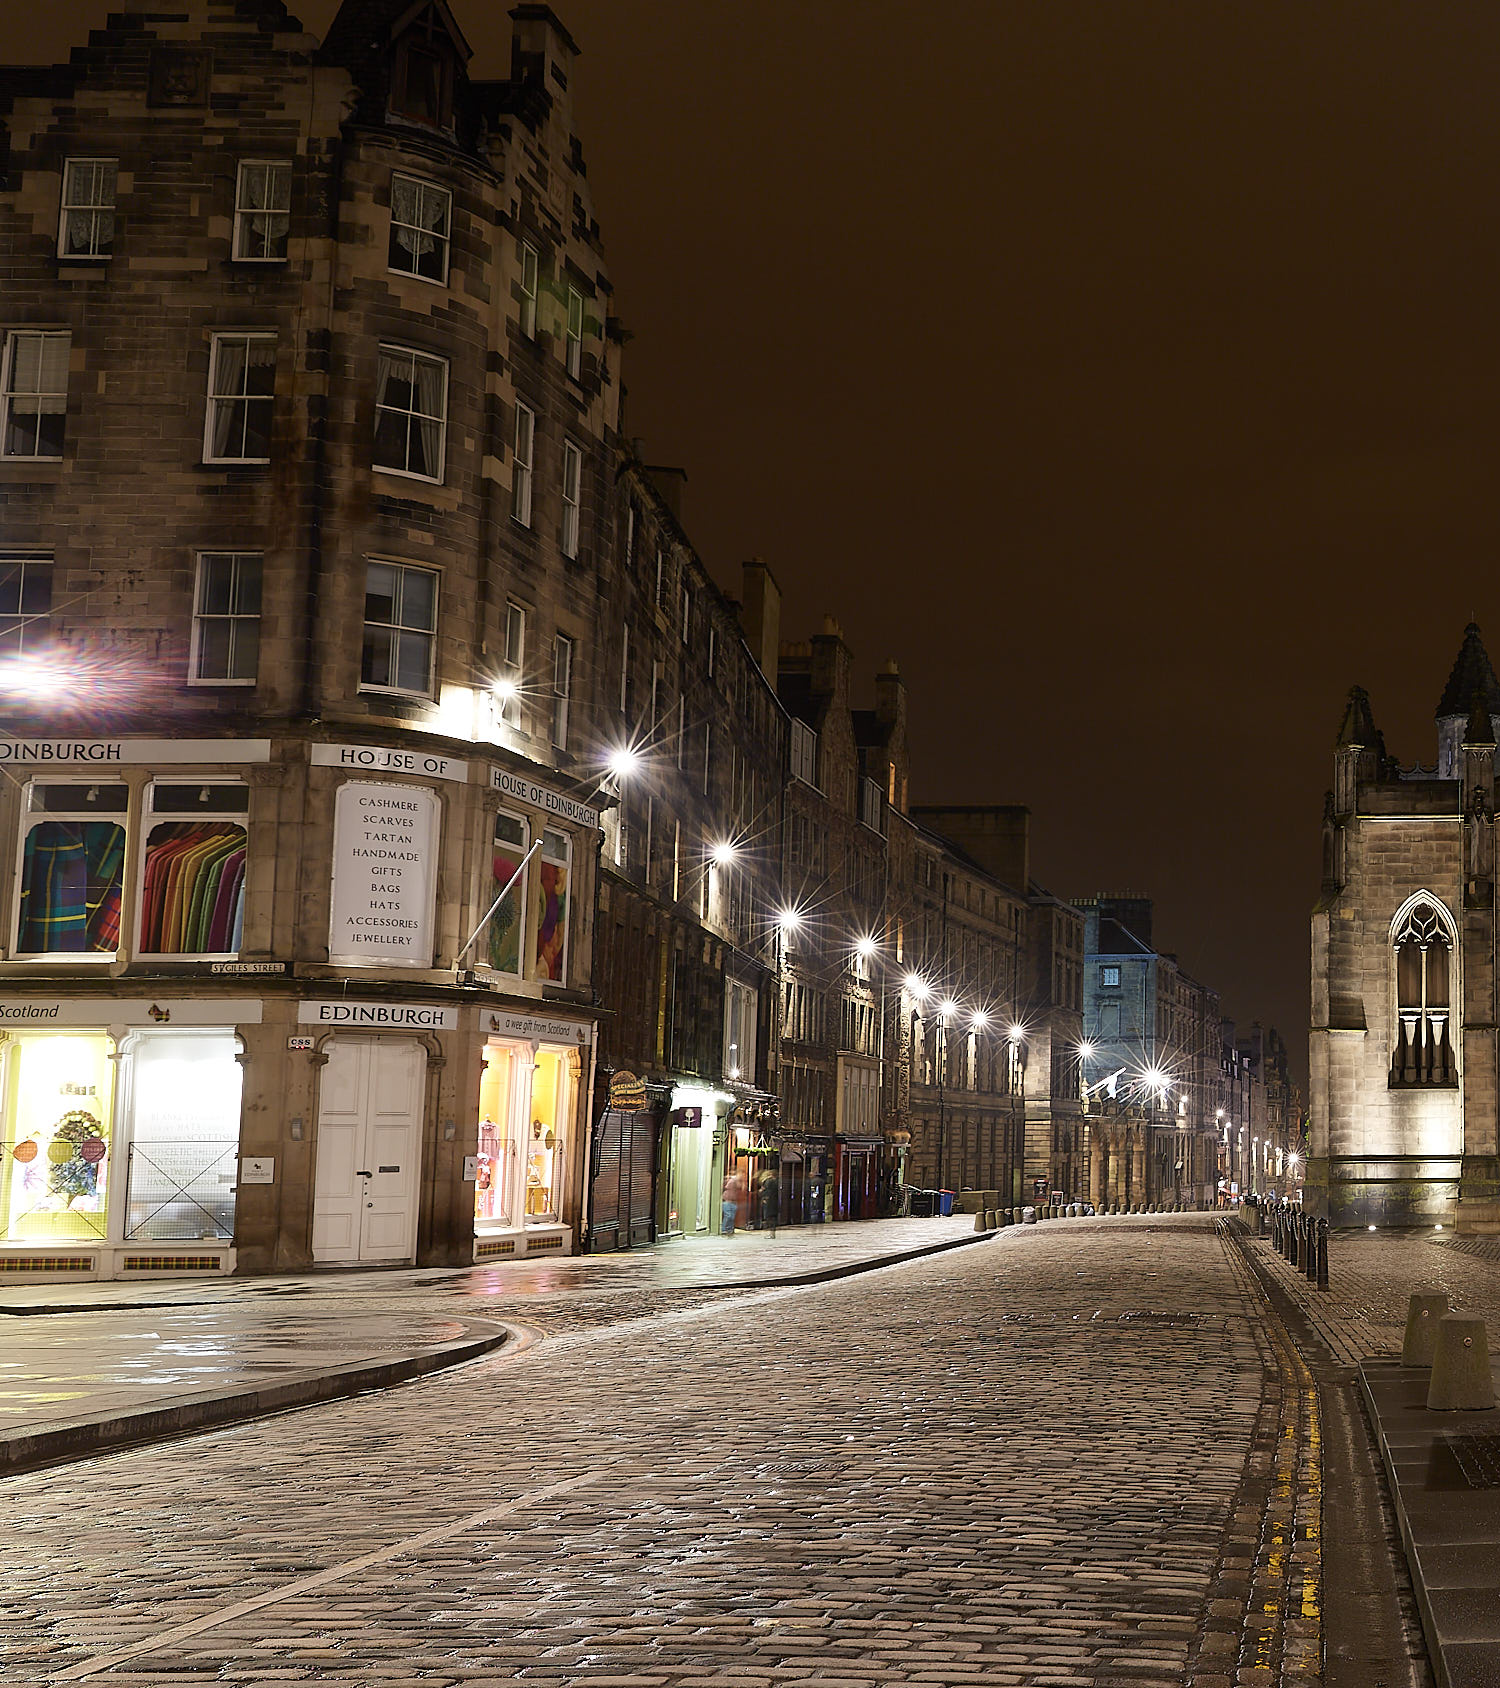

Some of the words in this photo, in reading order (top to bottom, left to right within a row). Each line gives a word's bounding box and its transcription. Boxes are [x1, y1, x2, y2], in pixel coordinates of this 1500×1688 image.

[341, 749, 415, 769] HOUSE
[423, 759, 448, 773] OF
[494, 771, 526, 797] HOUSE
[530, 788, 543, 803] OF
[546, 793, 595, 825] EDINBURGH
[359, 798, 419, 811] CASHMERE
[363, 815, 414, 827] SCARVES
[364, 832, 412, 843] TARTAN
[352, 848, 419, 861] HANDMADE
[371, 866, 402, 876] GIFTS
[371, 883, 400, 893] BAGS
[370, 900, 400, 910] HATS
[346, 916, 419, 928] ACCESSORIES
[351, 934, 412, 945] JEWELLERY
[225, 964, 248, 972] GILES
[253, 964, 283, 972] STREET
[0, 1005, 59, 1018] Scotland
[319, 1005, 444, 1025] EDINBURGH
[505, 1019, 511, 1028] a
[511, 1020, 522, 1030] wee
[522, 1020, 533, 1034] gift
[533, 1021, 547, 1034] from
[547, 1023, 570, 1036] Scotland
